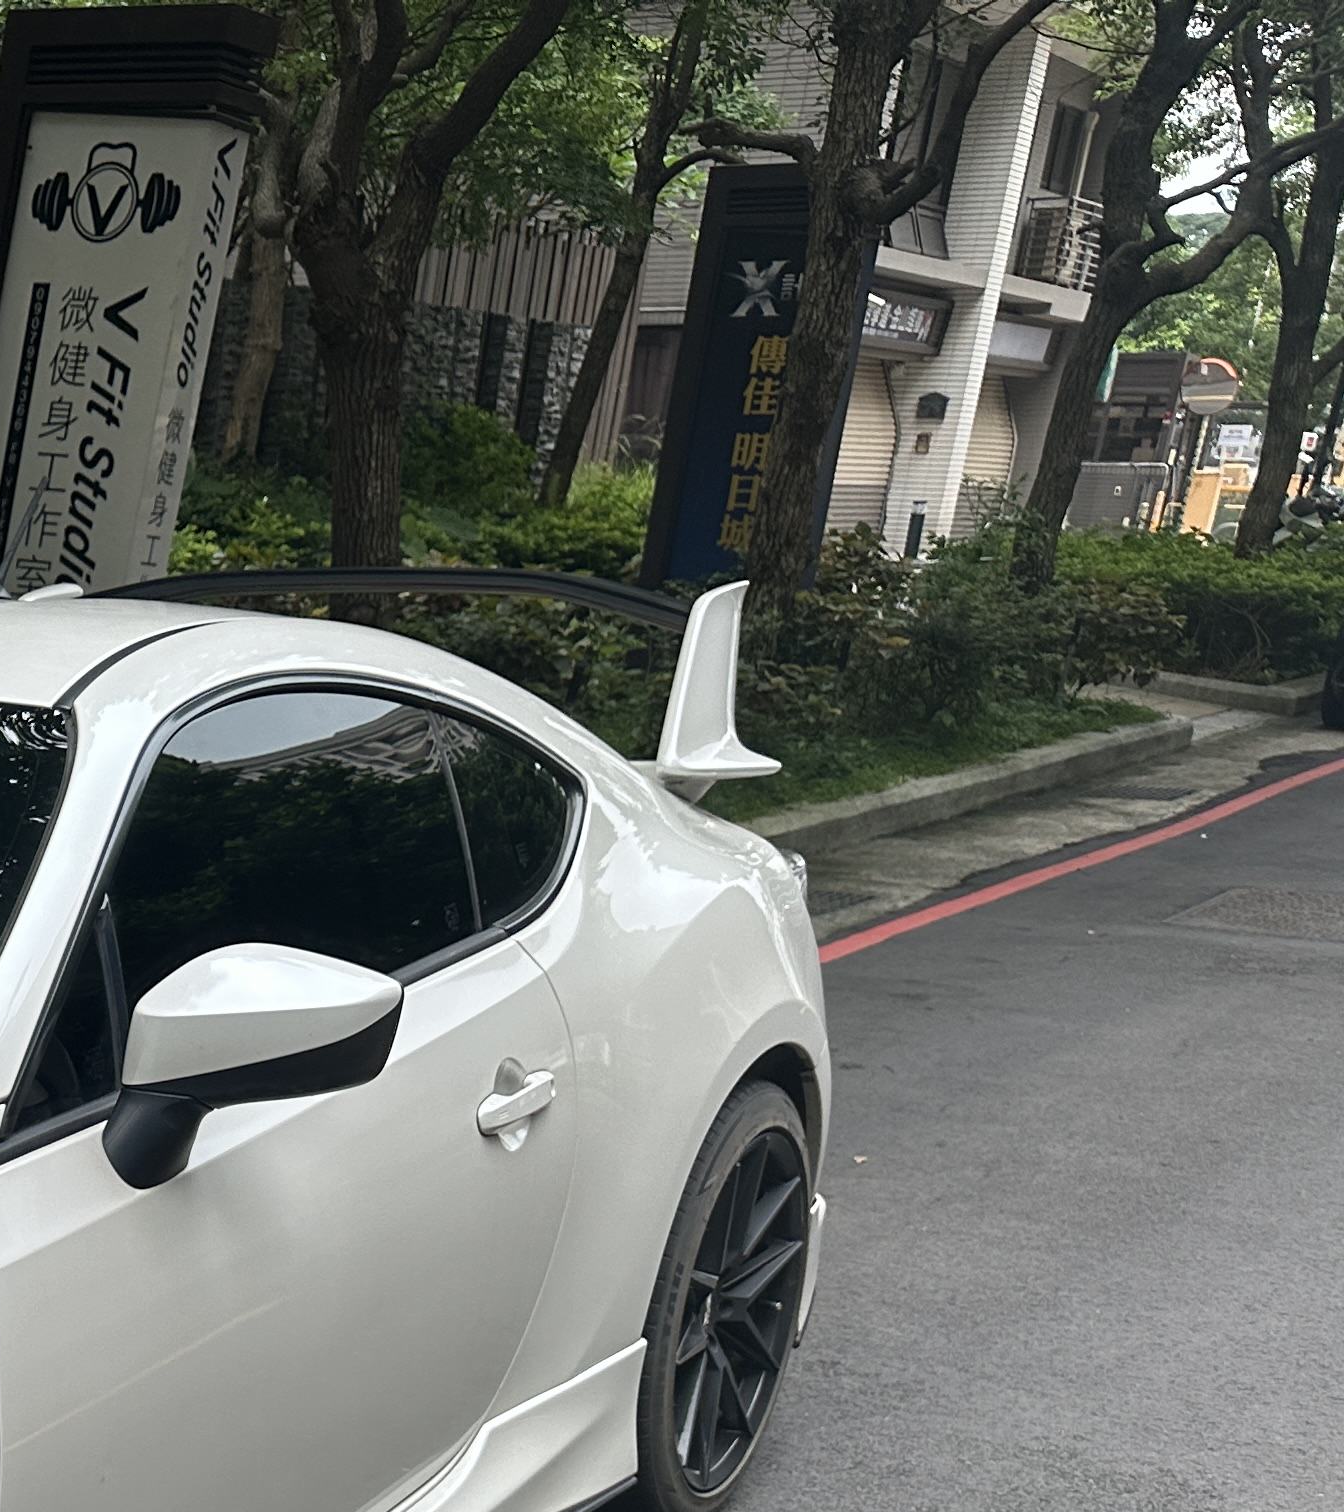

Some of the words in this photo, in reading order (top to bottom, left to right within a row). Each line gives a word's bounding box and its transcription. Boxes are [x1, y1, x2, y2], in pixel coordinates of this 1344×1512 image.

[103, 286, 149, 343] V
[177, 251, 212, 389] Studio
[15, 284, 99, 593] 微健身工作室
[86, 346, 131, 428] Fit
[140, 407, 185, 582] 微健身工
